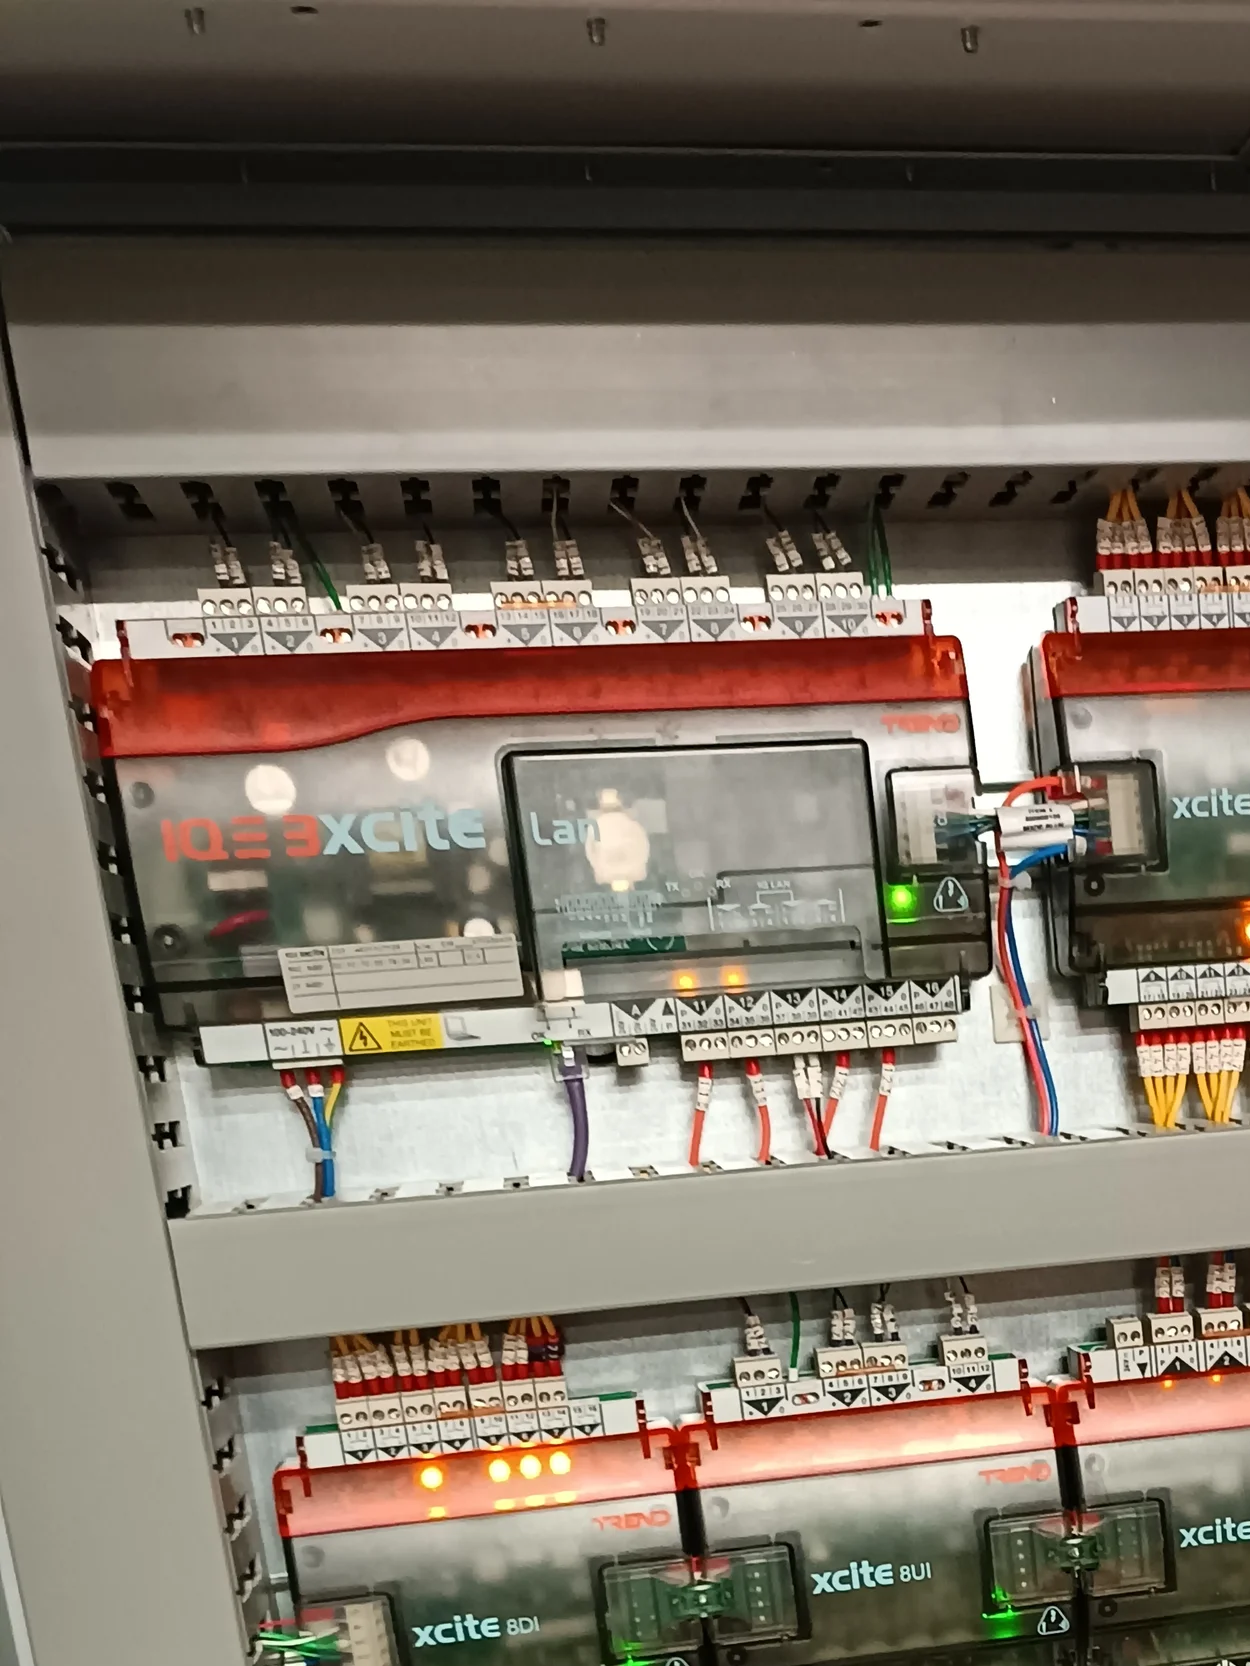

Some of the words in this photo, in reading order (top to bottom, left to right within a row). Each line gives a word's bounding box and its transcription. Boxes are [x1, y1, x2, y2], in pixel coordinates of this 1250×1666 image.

[1172, 788, 1250, 819] xcite
[693, 1000, 708, 1011] 11
[739, 997, 754, 1009] 12
[786, 993, 801, 1004] 13
[833, 989, 848, 1000] 14
[879, 987, 894, 998] 15
[926, 982, 940, 994] 16
[811, 1560, 894, 1594] xcite
[900, 1562, 931, 1583] 8UI
[412, 1613, 500, 1648] xcite
[506, 1616, 540, 1636] 8DI
